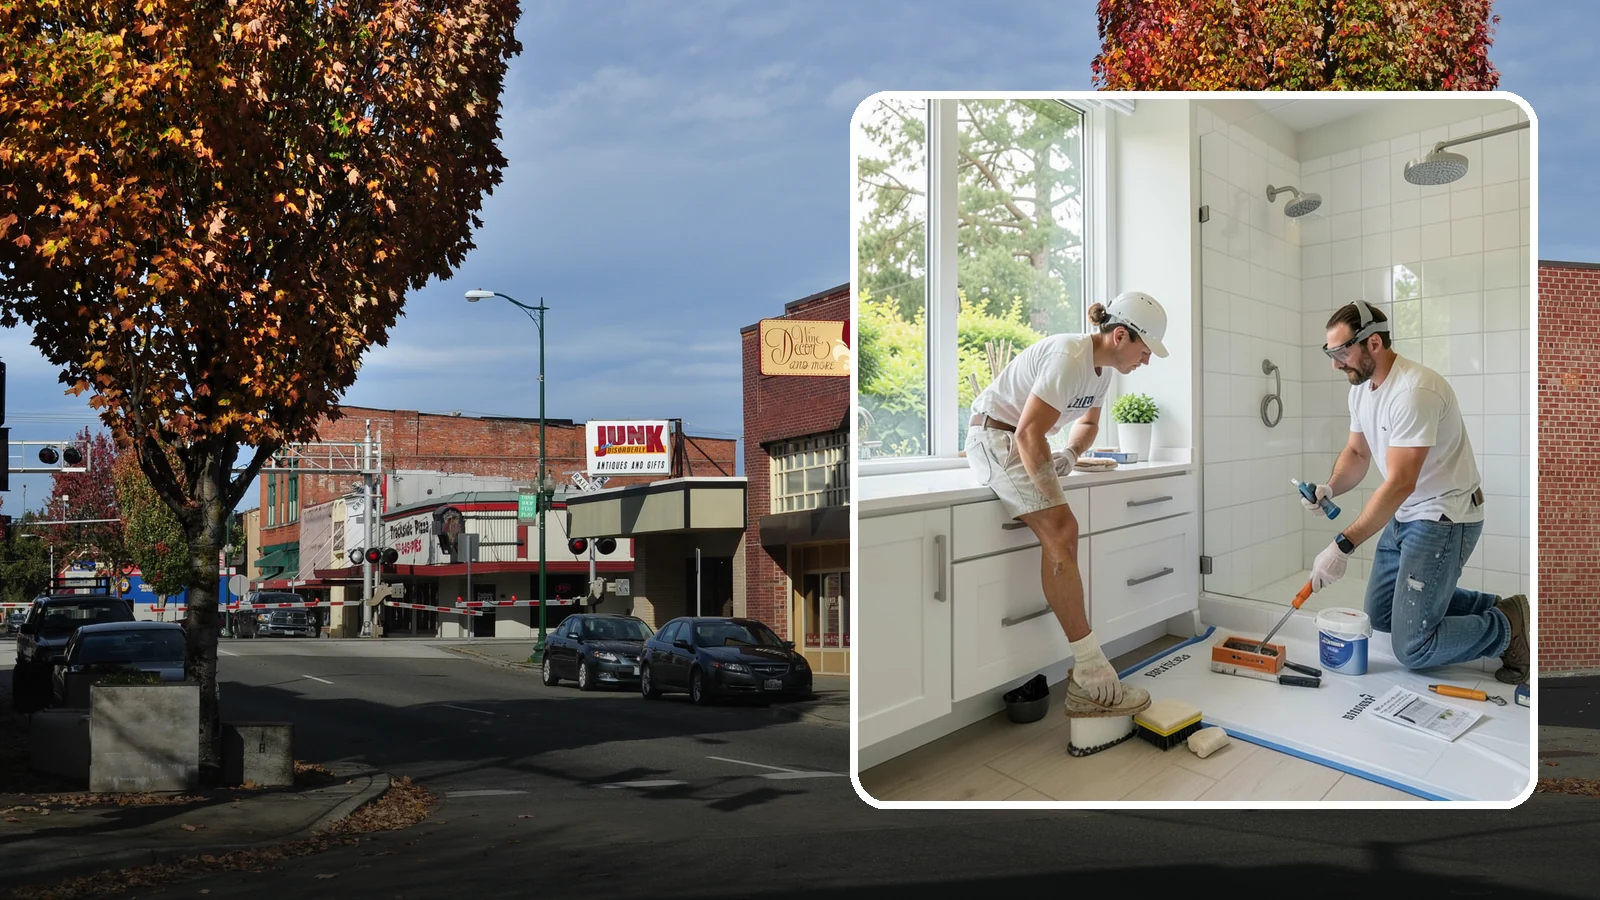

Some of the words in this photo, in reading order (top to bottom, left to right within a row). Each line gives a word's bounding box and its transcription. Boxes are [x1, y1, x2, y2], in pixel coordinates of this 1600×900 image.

[595, 425, 666, 457] JUNK
[607, 446, 646, 454] DISORDERLY
[596, 461, 628, 470] ANTIQUES
[631, 461, 644, 470] AND
[646, 460, 666, 470] GIFTS
[352, 498, 365, 511] CRO
[390, 521, 413, 540] Trackside
[414, 519, 429, 535] Pizza
